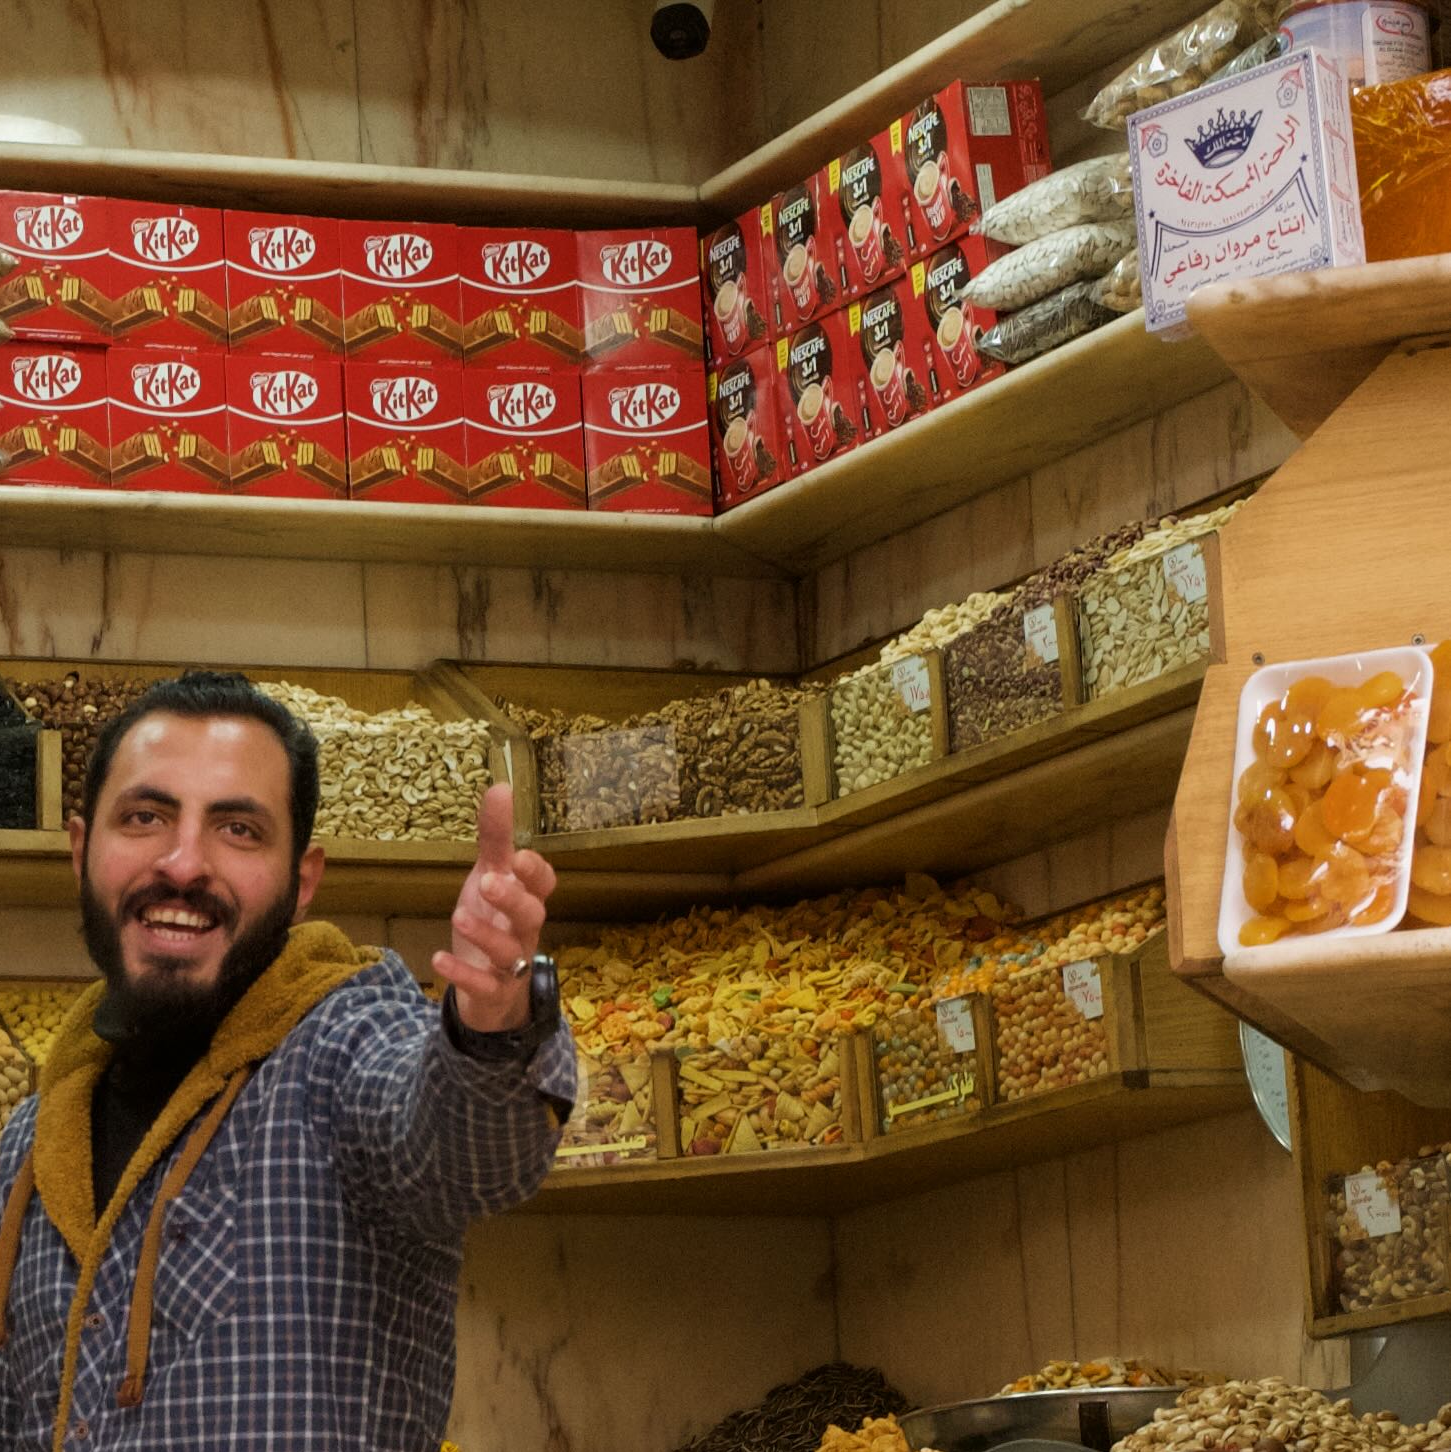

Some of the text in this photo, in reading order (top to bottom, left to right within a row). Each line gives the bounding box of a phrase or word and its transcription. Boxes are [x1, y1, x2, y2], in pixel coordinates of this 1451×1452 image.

[1261, 114, 1301, 176] الراحة
[1155, 161, 1202, 202] الفاخرة
[25, 206, 80, 248] KitKat
[142, 217, 194, 261] KitKat
[259, 227, 311, 270] KitKat
[1215, 234, 1261, 262] مروان
[375, 234, 429, 277] KitKat
[493, 241, 547, 284] KitKat
[611, 241, 668, 285] KitKat
[1164, 249, 1210, 288] رفاعي
[22, 355, 78, 399] KitKat
[142, 363, 196, 406] KitKat
[260, 372, 314, 414] KitKat
[381, 377, 434, 420] KitKat
[497, 383, 553, 426] KitKat
[620, 383, 677, 427] KitKat
